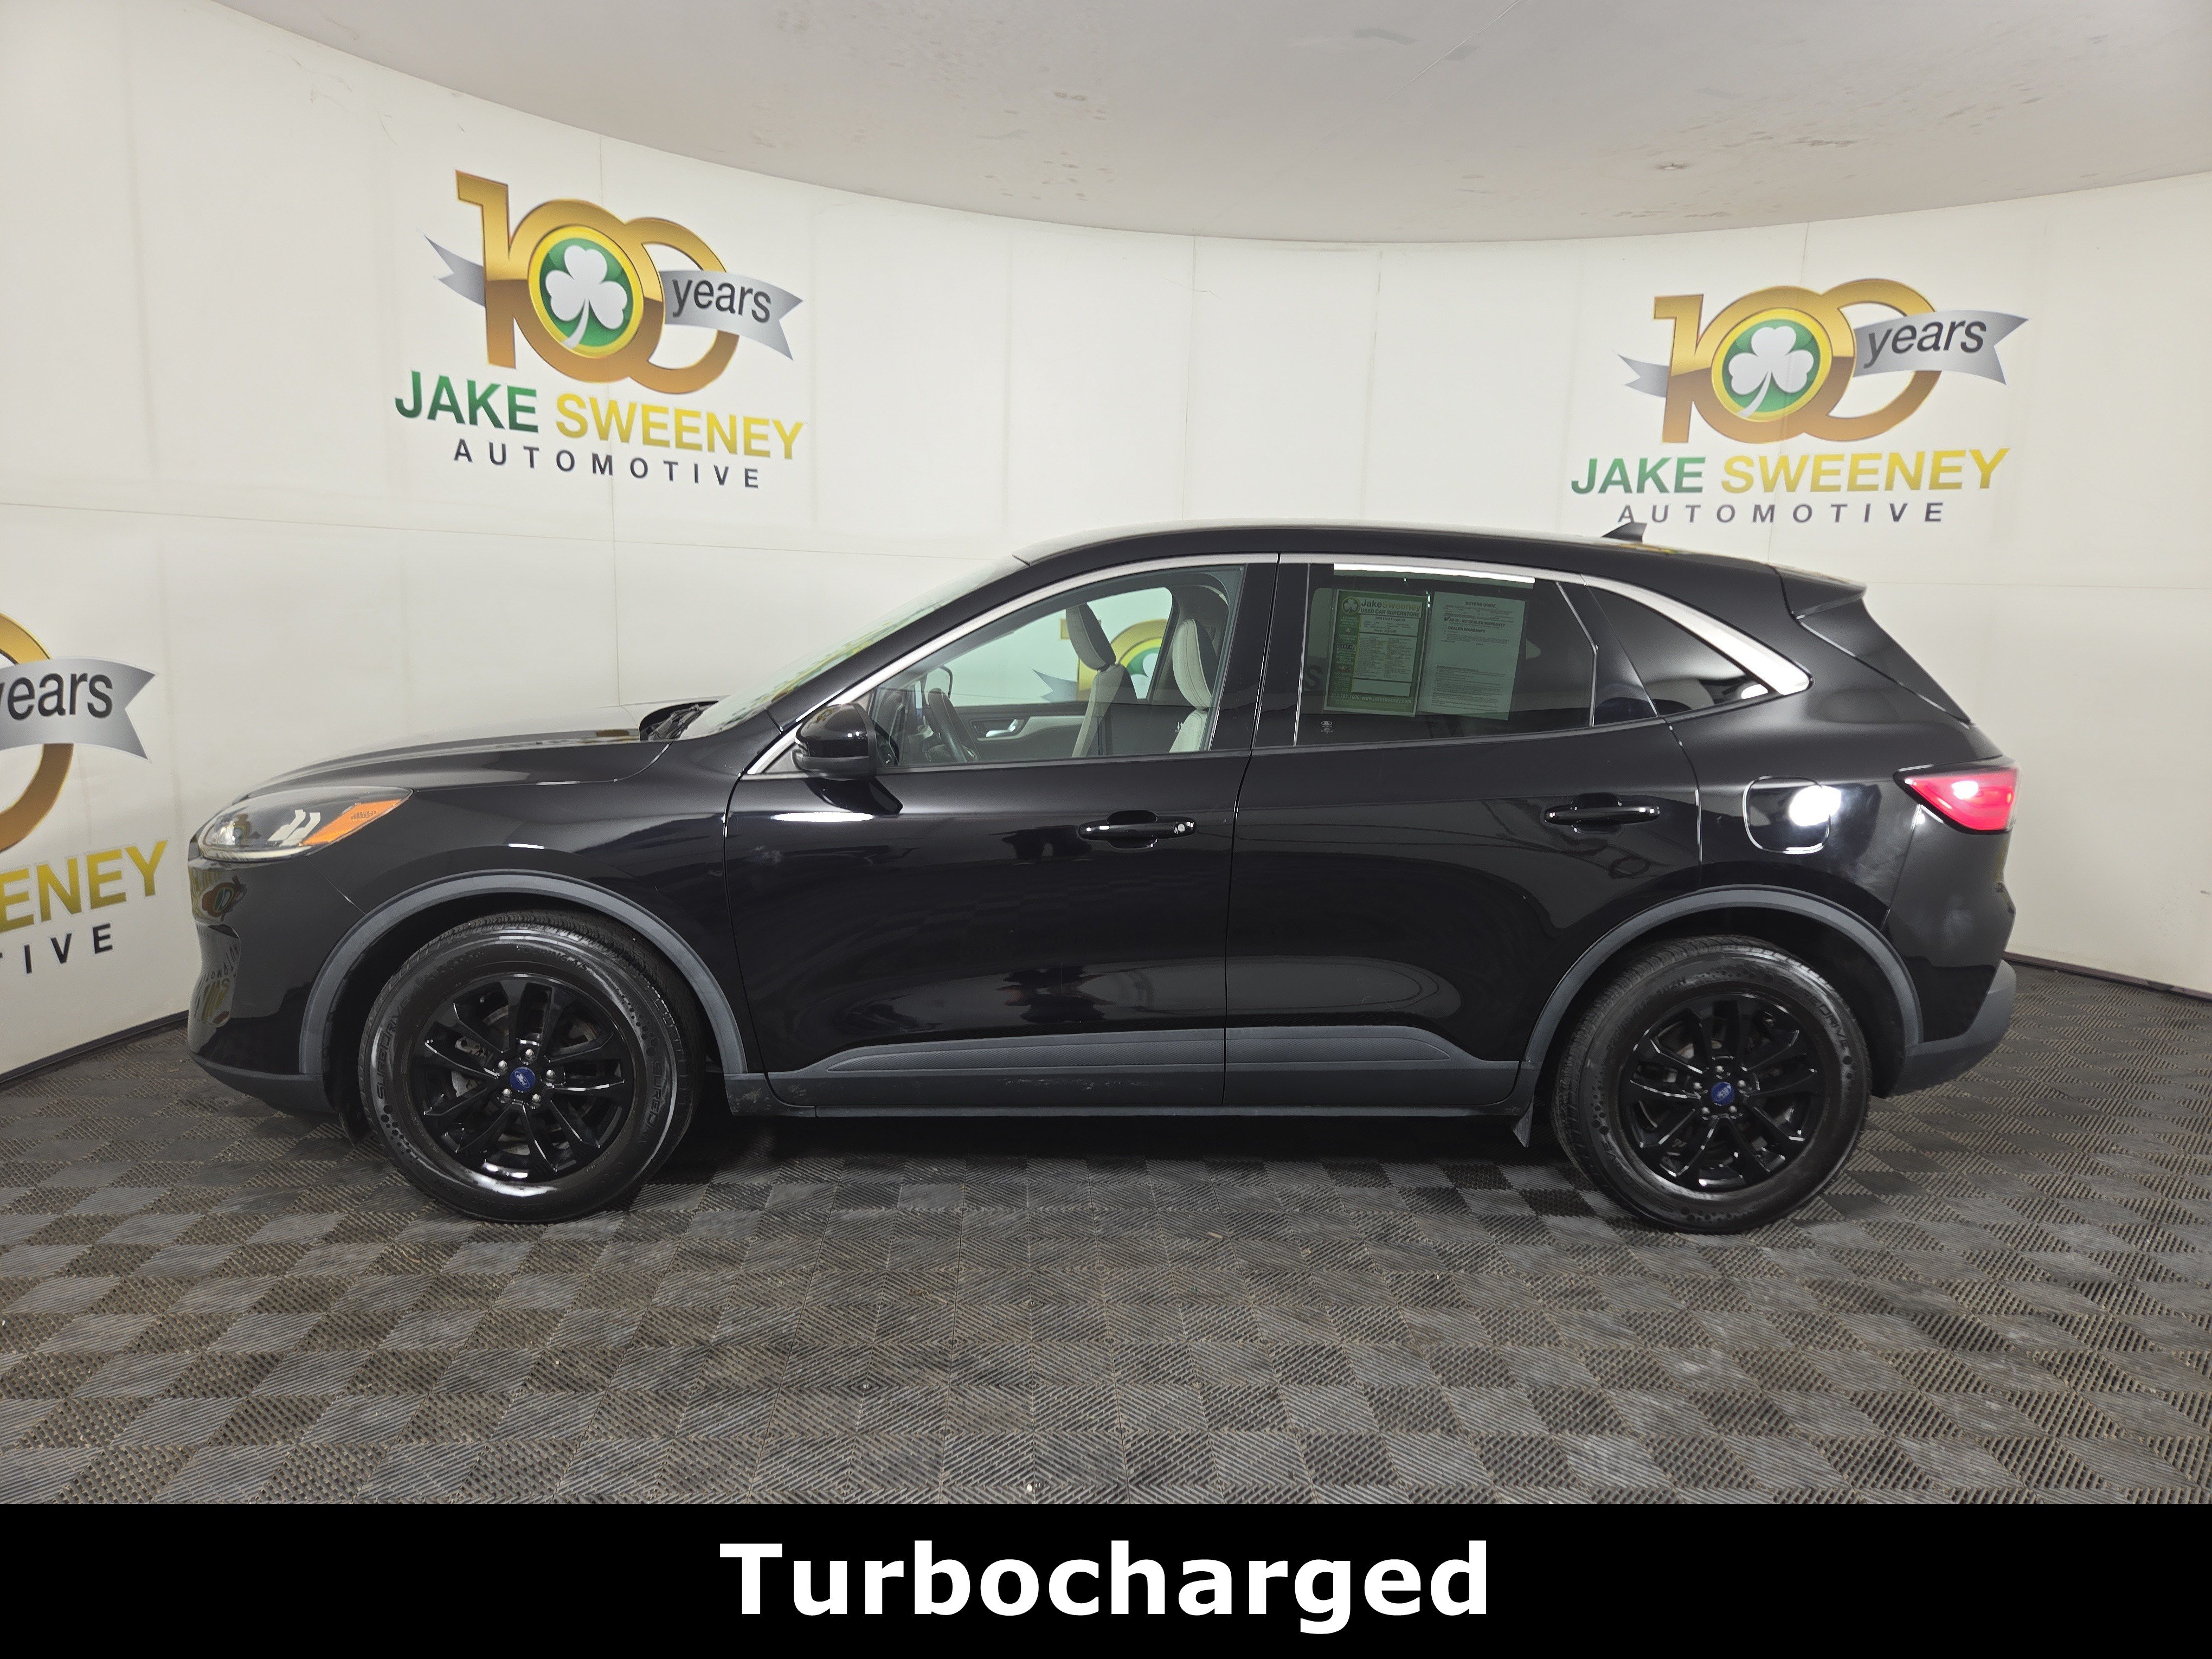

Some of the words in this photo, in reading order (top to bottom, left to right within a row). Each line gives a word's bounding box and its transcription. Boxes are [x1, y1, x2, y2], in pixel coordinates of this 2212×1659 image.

[672, 278, 771, 324] years
[1863, 320, 1987, 369] years
[395, 370, 539, 434] JAKE
[556, 393, 805, 460] SWEENEY
[454, 438, 759, 488] AUTOMOTIVE
[1571, 456, 1706, 494] JAKE
[1721, 448, 2011, 494] SWEENEY
[1617, 501, 1944, 523] AUTOMOTIVE
[0, 923, 113, 974] IVE
